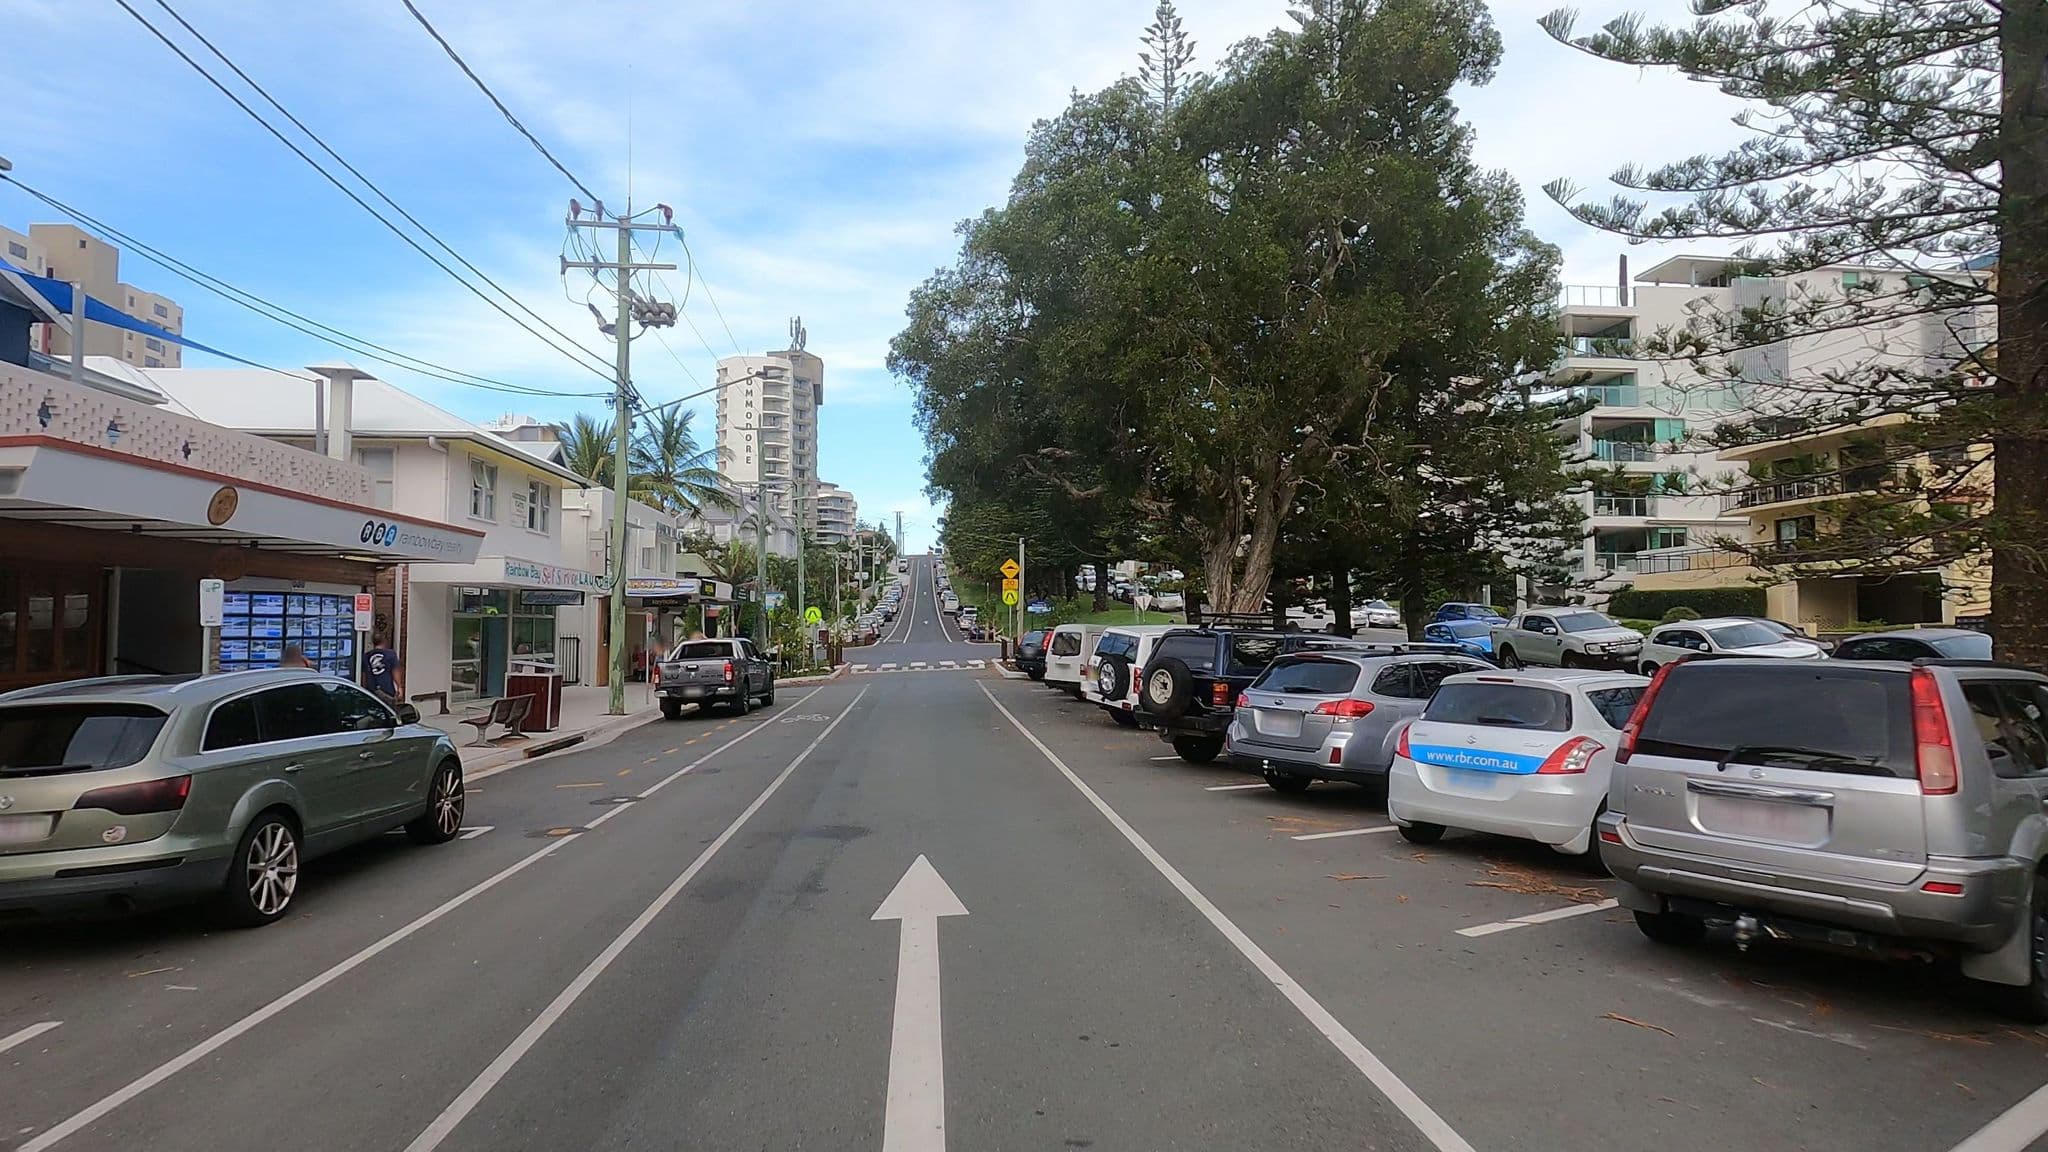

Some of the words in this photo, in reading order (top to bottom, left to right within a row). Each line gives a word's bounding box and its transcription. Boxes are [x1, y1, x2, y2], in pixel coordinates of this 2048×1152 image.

[745, 367, 753, 464] COMMODORE
[505, 561, 529, 577] Rainbow
[530, 565, 541, 584] Bay
[1427, 751, 1518, 769] www.rbr.com.au
